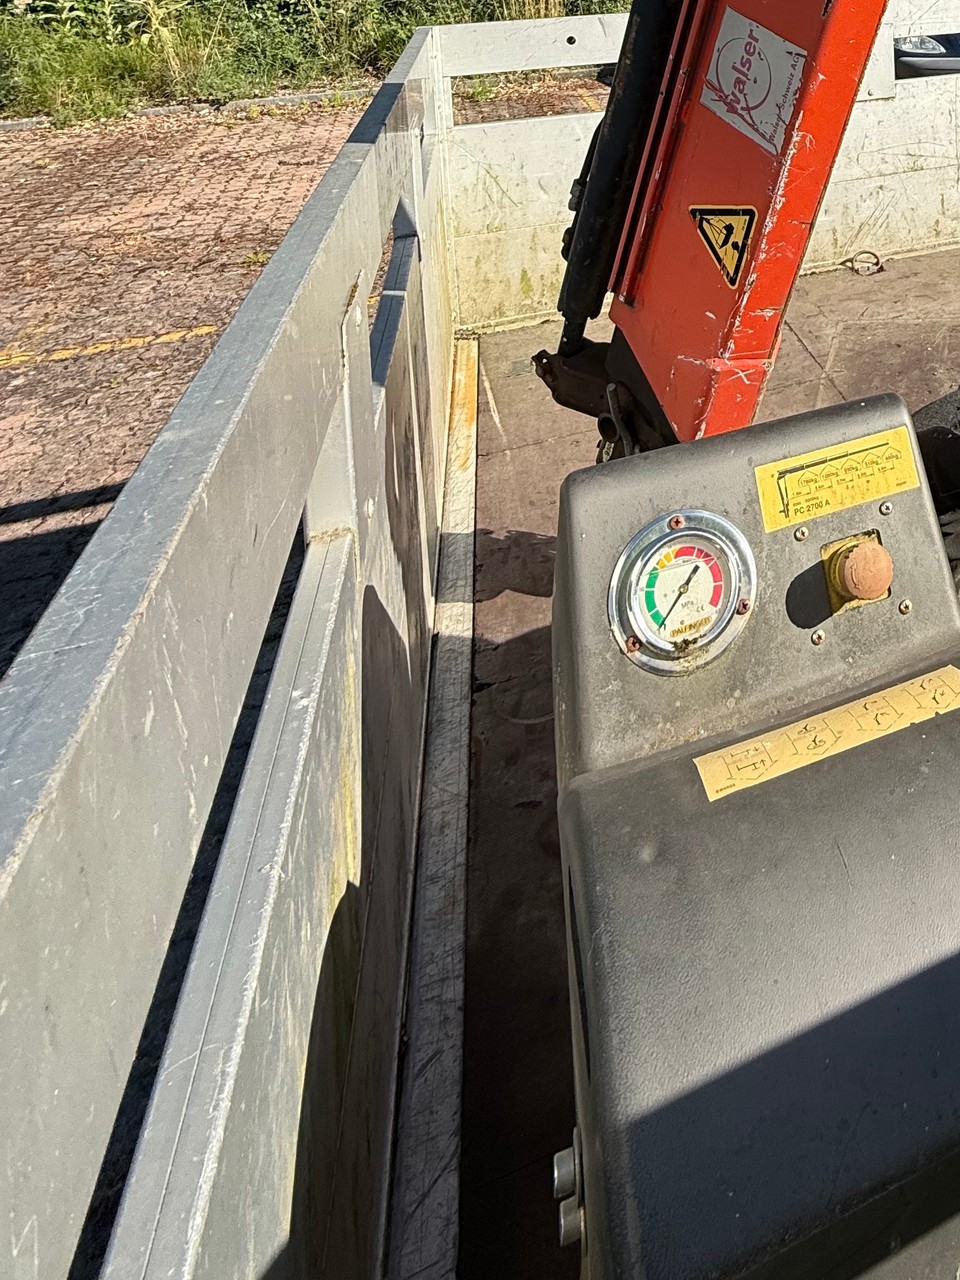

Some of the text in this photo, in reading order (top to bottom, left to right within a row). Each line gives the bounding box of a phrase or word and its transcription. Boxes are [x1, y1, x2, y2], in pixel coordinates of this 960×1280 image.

[725, 28, 759, 115] walser
[780, 72, 795, 111] Schweiz
[794, 506, 805, 516] PC
[806, 500, 824, 512] 2700
